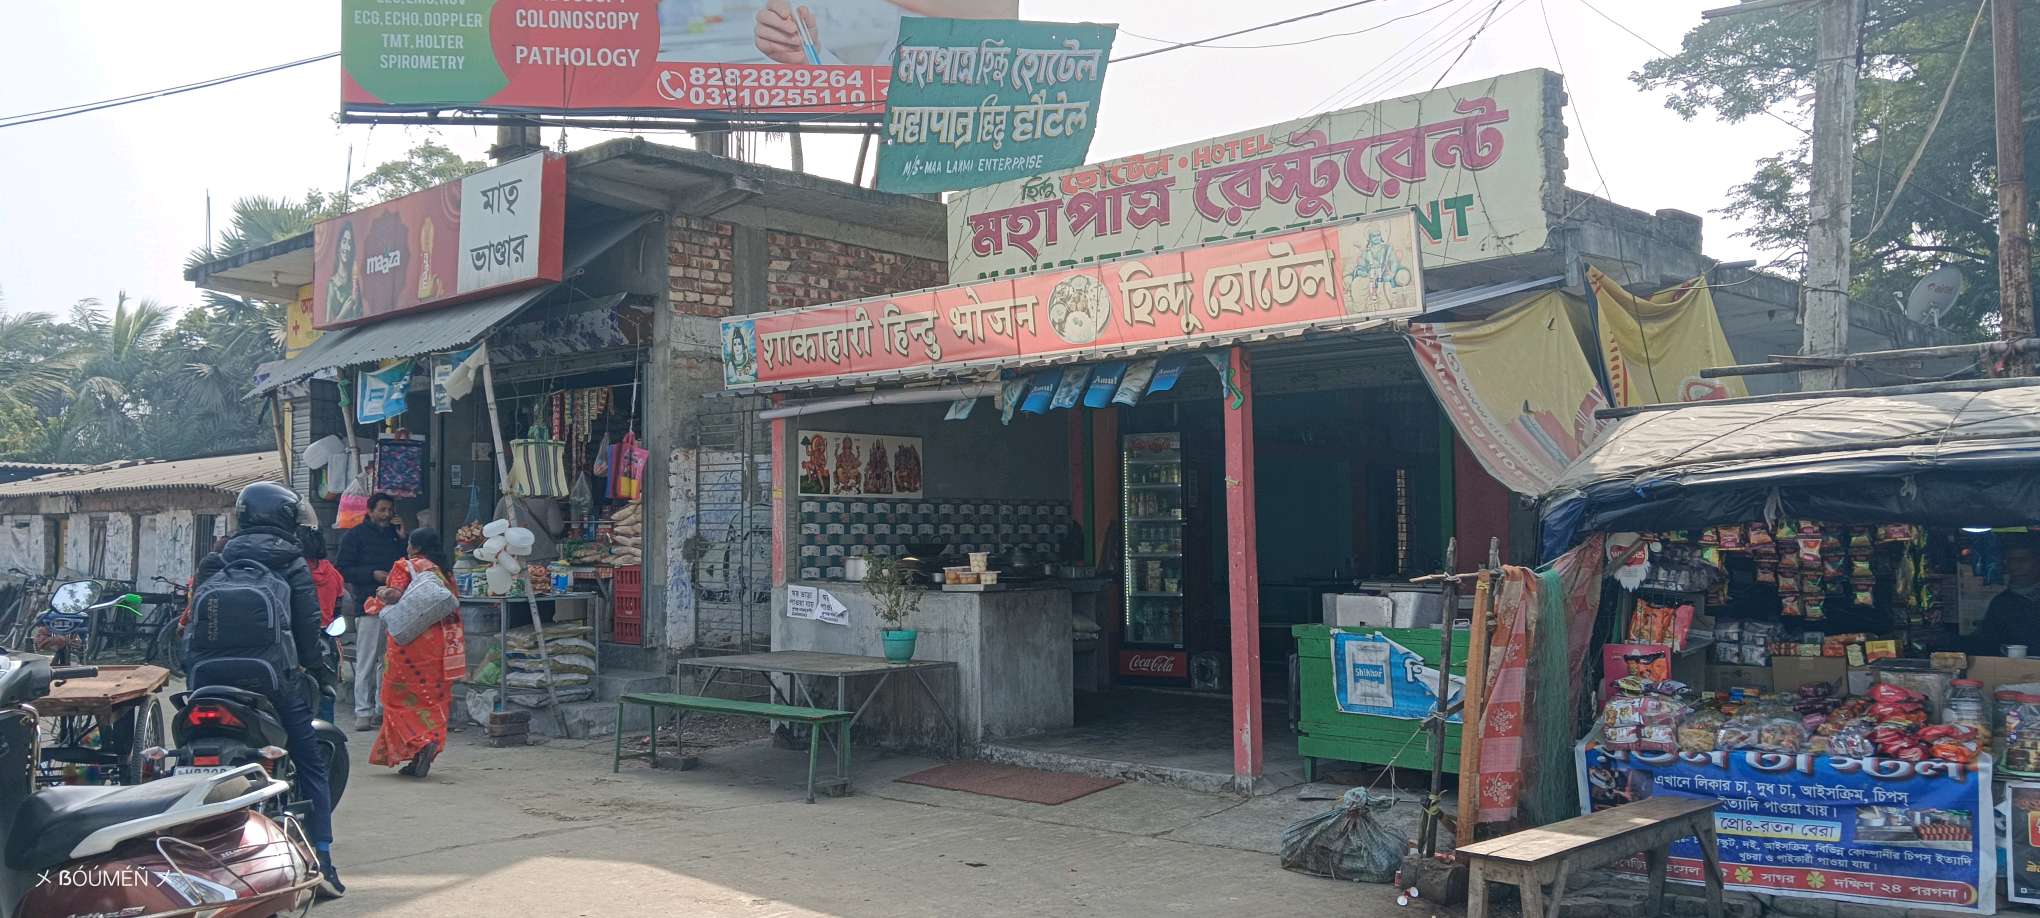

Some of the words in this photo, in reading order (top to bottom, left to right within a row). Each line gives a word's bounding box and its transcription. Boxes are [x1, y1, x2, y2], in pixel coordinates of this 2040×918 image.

[516, 9, 640, 30] COLONOSCOPY
[381, 34, 464, 49] TMT.HOLTER
[380, 55, 465, 70] SPIROMETRY
[515, 46, 640, 67] PATHOLOGY
[1010, 39, 1101, 95] হোটেল
[689, 67, 864, 88] 8282829264
[689, 87, 865, 107] 03210255110
[977, 154, 1043, 172] ENTERPRISE
[1060, 154, 1173, 196] হোটেল
[1192, 133, 1275, 169] HOTEL
[967, 177, 1177, 263] মহাপাত্র
[1193, 97, 1510, 226] রেস্টুরেন্ট
[480, 178, 523, 216] মাতৃ
[366, 249, 401, 275] maaza
[470, 234, 529, 273] ভাণ্ডার
[1202, 240, 1337, 319] হোটেল
[759, 306, 873, 370] शाकाहारी
[879, 304, 942, 361] हिन्दु
[949, 286, 1039, 344] भोजन
[1094, 375, 1118, 385] Amul
[1654, 774, 1690, 788] এখানে
[1695, 774, 1731, 792] লিকার
[1734, 781, 1751, 793] চা,
[1756, 782, 1774, 798] দুধ
[1779, 783, 1796, 799] চা,
[1800, 784, 1869, 803] আইসক্রিম,
[1872, 787, 1909, 807] চিপস্
[1764, 801, 1801, 815] পাওয়া
[1802, 824, 1834, 838] বেরা
[1765, 855, 1774, 863] ও
[1817, 856, 1848, 868] পাওয়া
[1935, 853, 1972, 867] ইত্যাদি
[1760, 872, 1796, 884] সাগর
[1834, 876, 1875, 892] দক্ষিণ
[1880, 882, 1902, 894] ২৪
